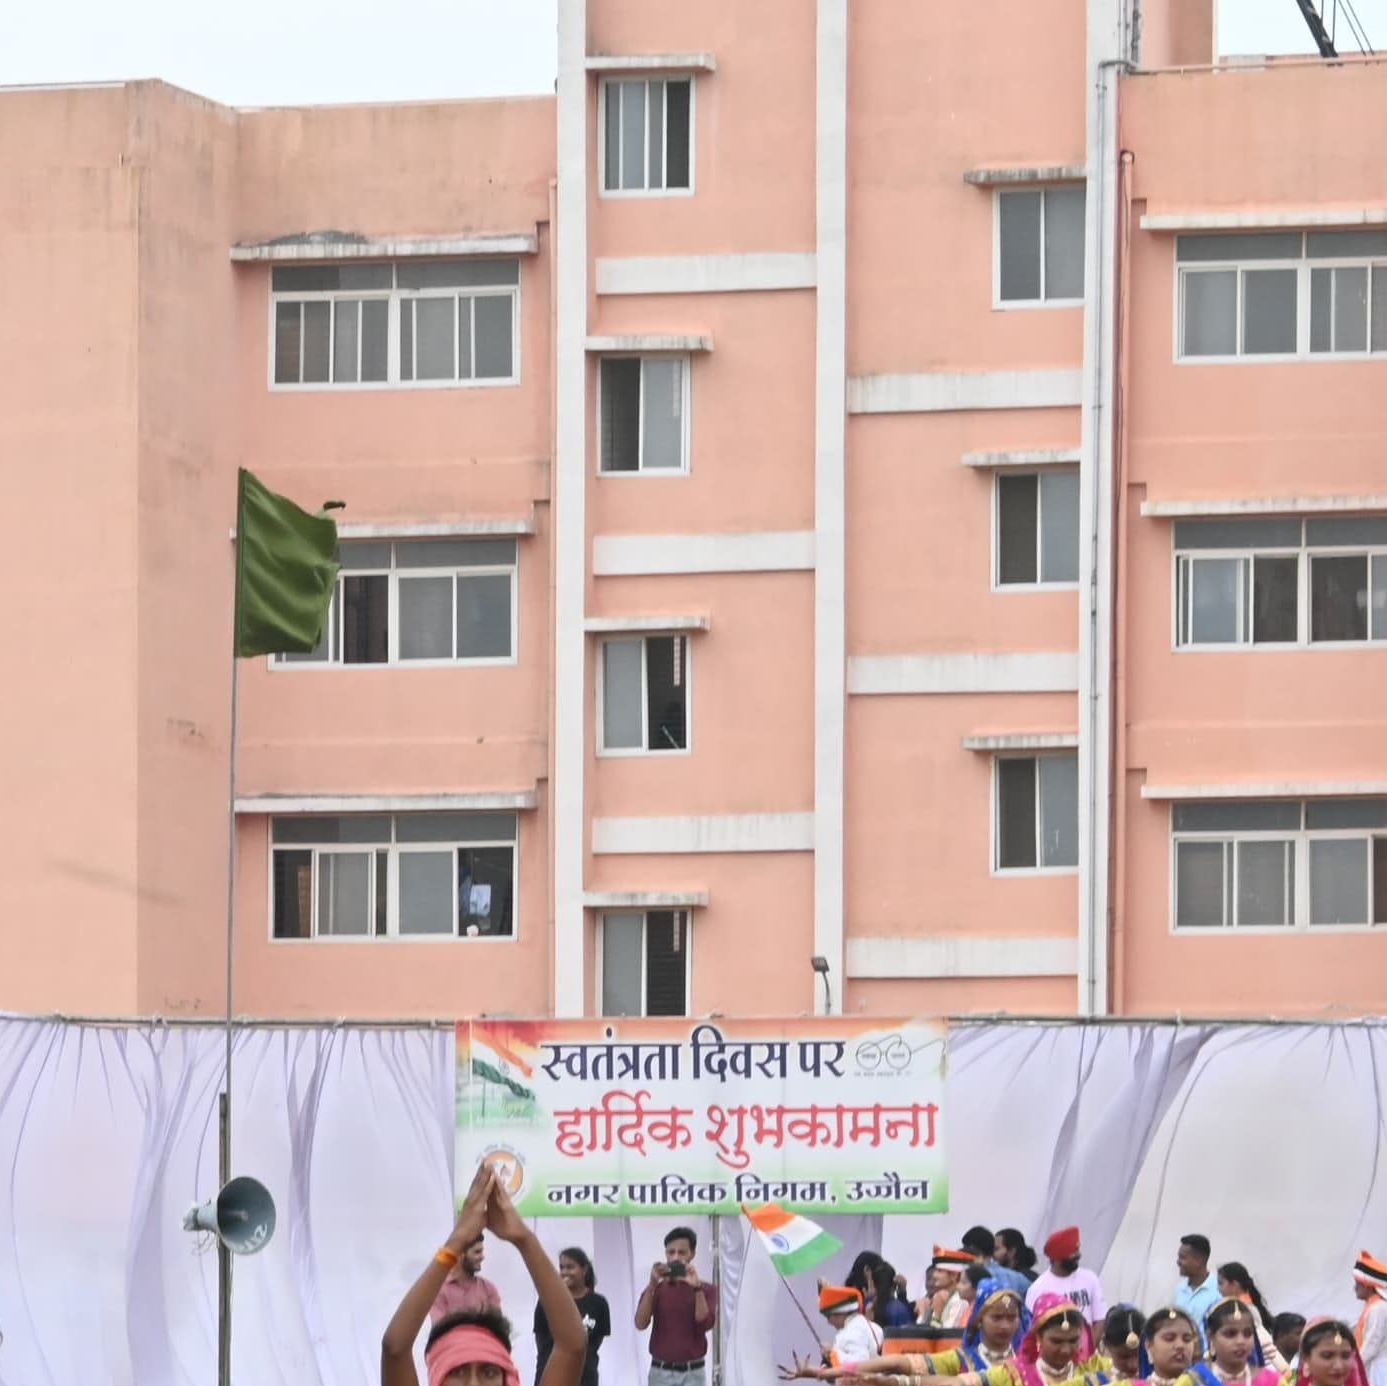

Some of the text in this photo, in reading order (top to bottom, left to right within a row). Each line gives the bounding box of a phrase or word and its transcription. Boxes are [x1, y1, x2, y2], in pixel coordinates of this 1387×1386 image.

[540, 1025, 846, 1082] स्वतंत्रता दिवस पर
[553, 1090, 939, 1169] हार्दिक शुभकामना
[547, 1183, 619, 1204] नगर
[627, 1174, 727, 1204] पालिक
[845, 1172, 930, 1201] उज्जैन
